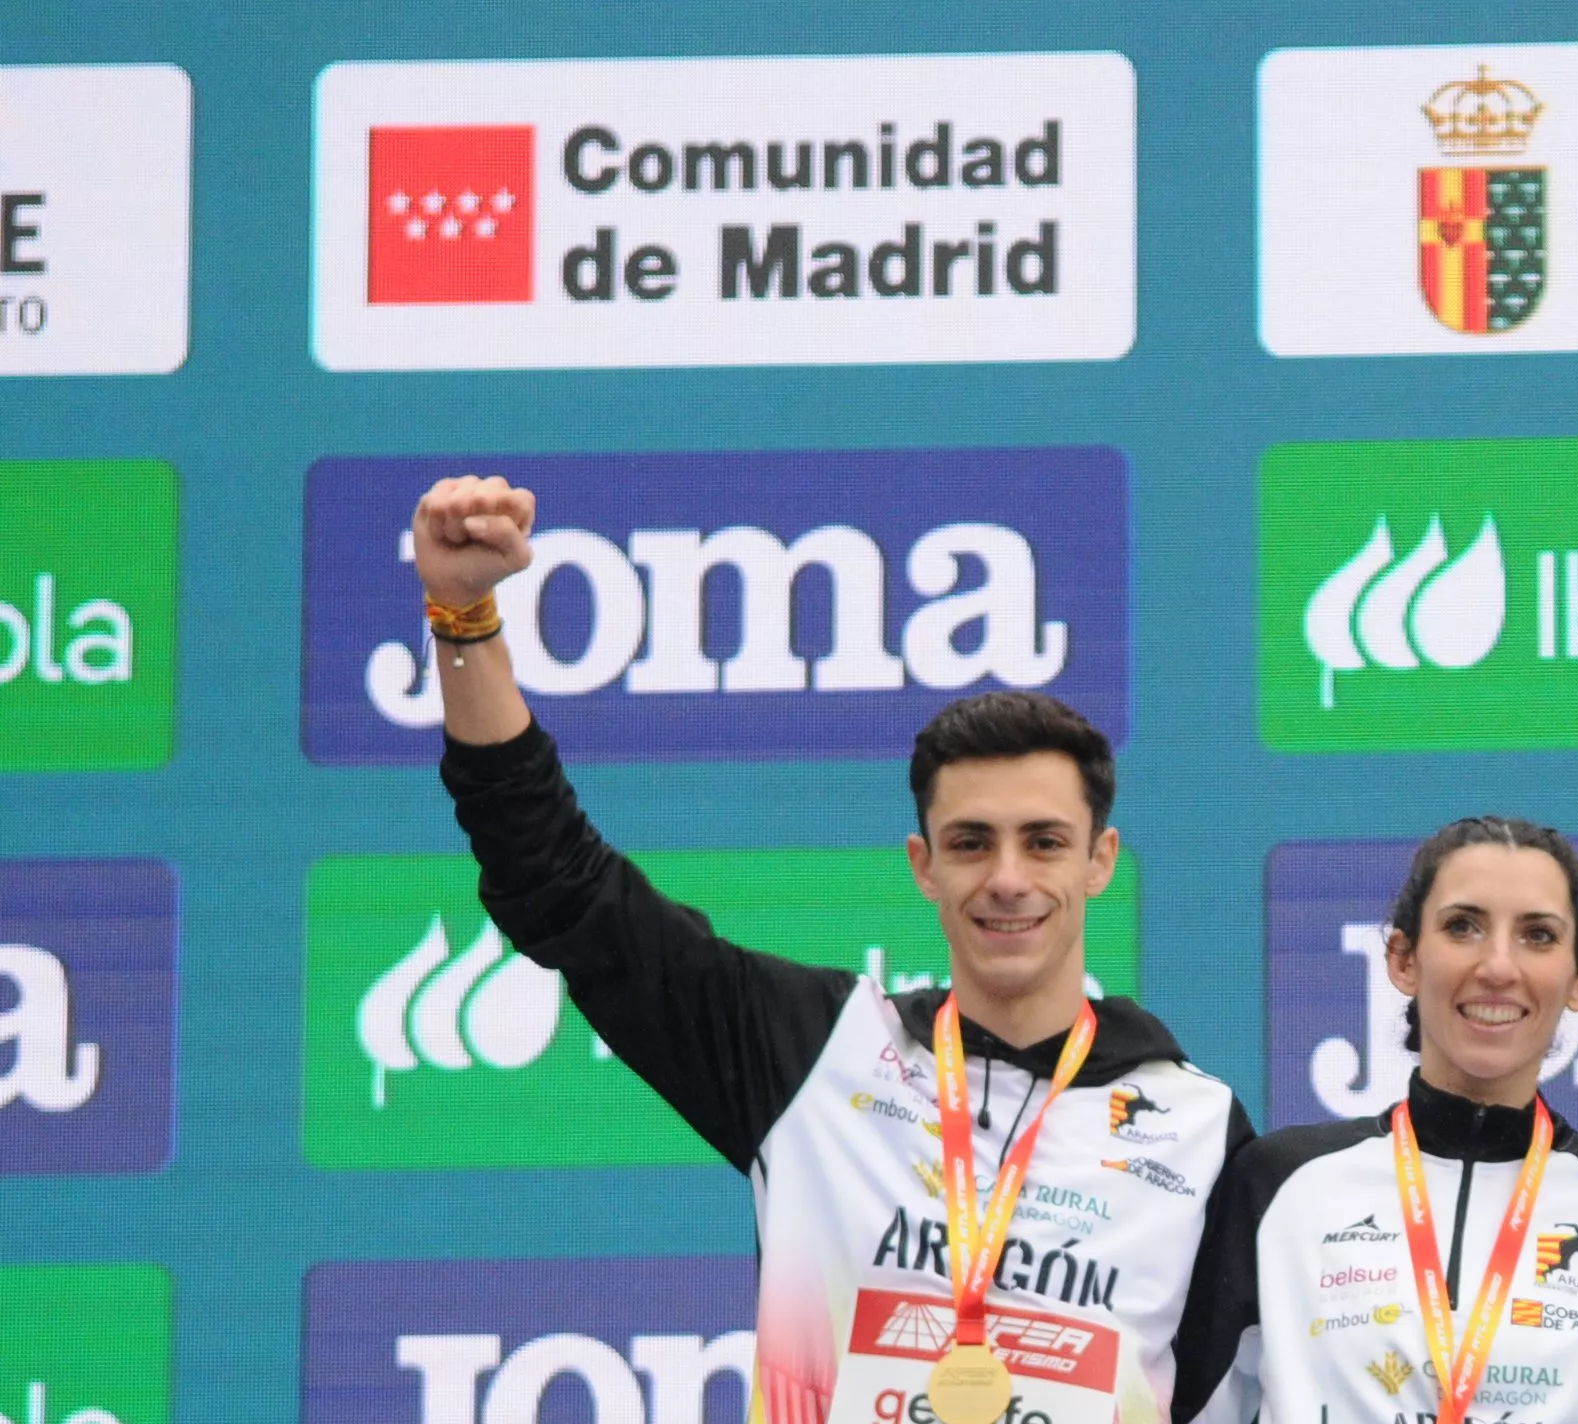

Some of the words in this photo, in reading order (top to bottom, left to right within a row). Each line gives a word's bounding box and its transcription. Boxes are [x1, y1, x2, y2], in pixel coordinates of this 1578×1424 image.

[562, 119, 1062, 193] Comunidad
[561, 226, 677, 301] de
[720, 220, 1060, 301] Madrid
[1034, 1184, 1112, 1221] RURAL
[1322, 1231, 1400, 1244] MERCURY
[873, 1206, 1119, 1311] ARGÓN
[1320, 1265, 1397, 1288] belsue
[1543, 1317, 1564, 1331] DE
[1486, 1365, 1564, 1386] RURAL
